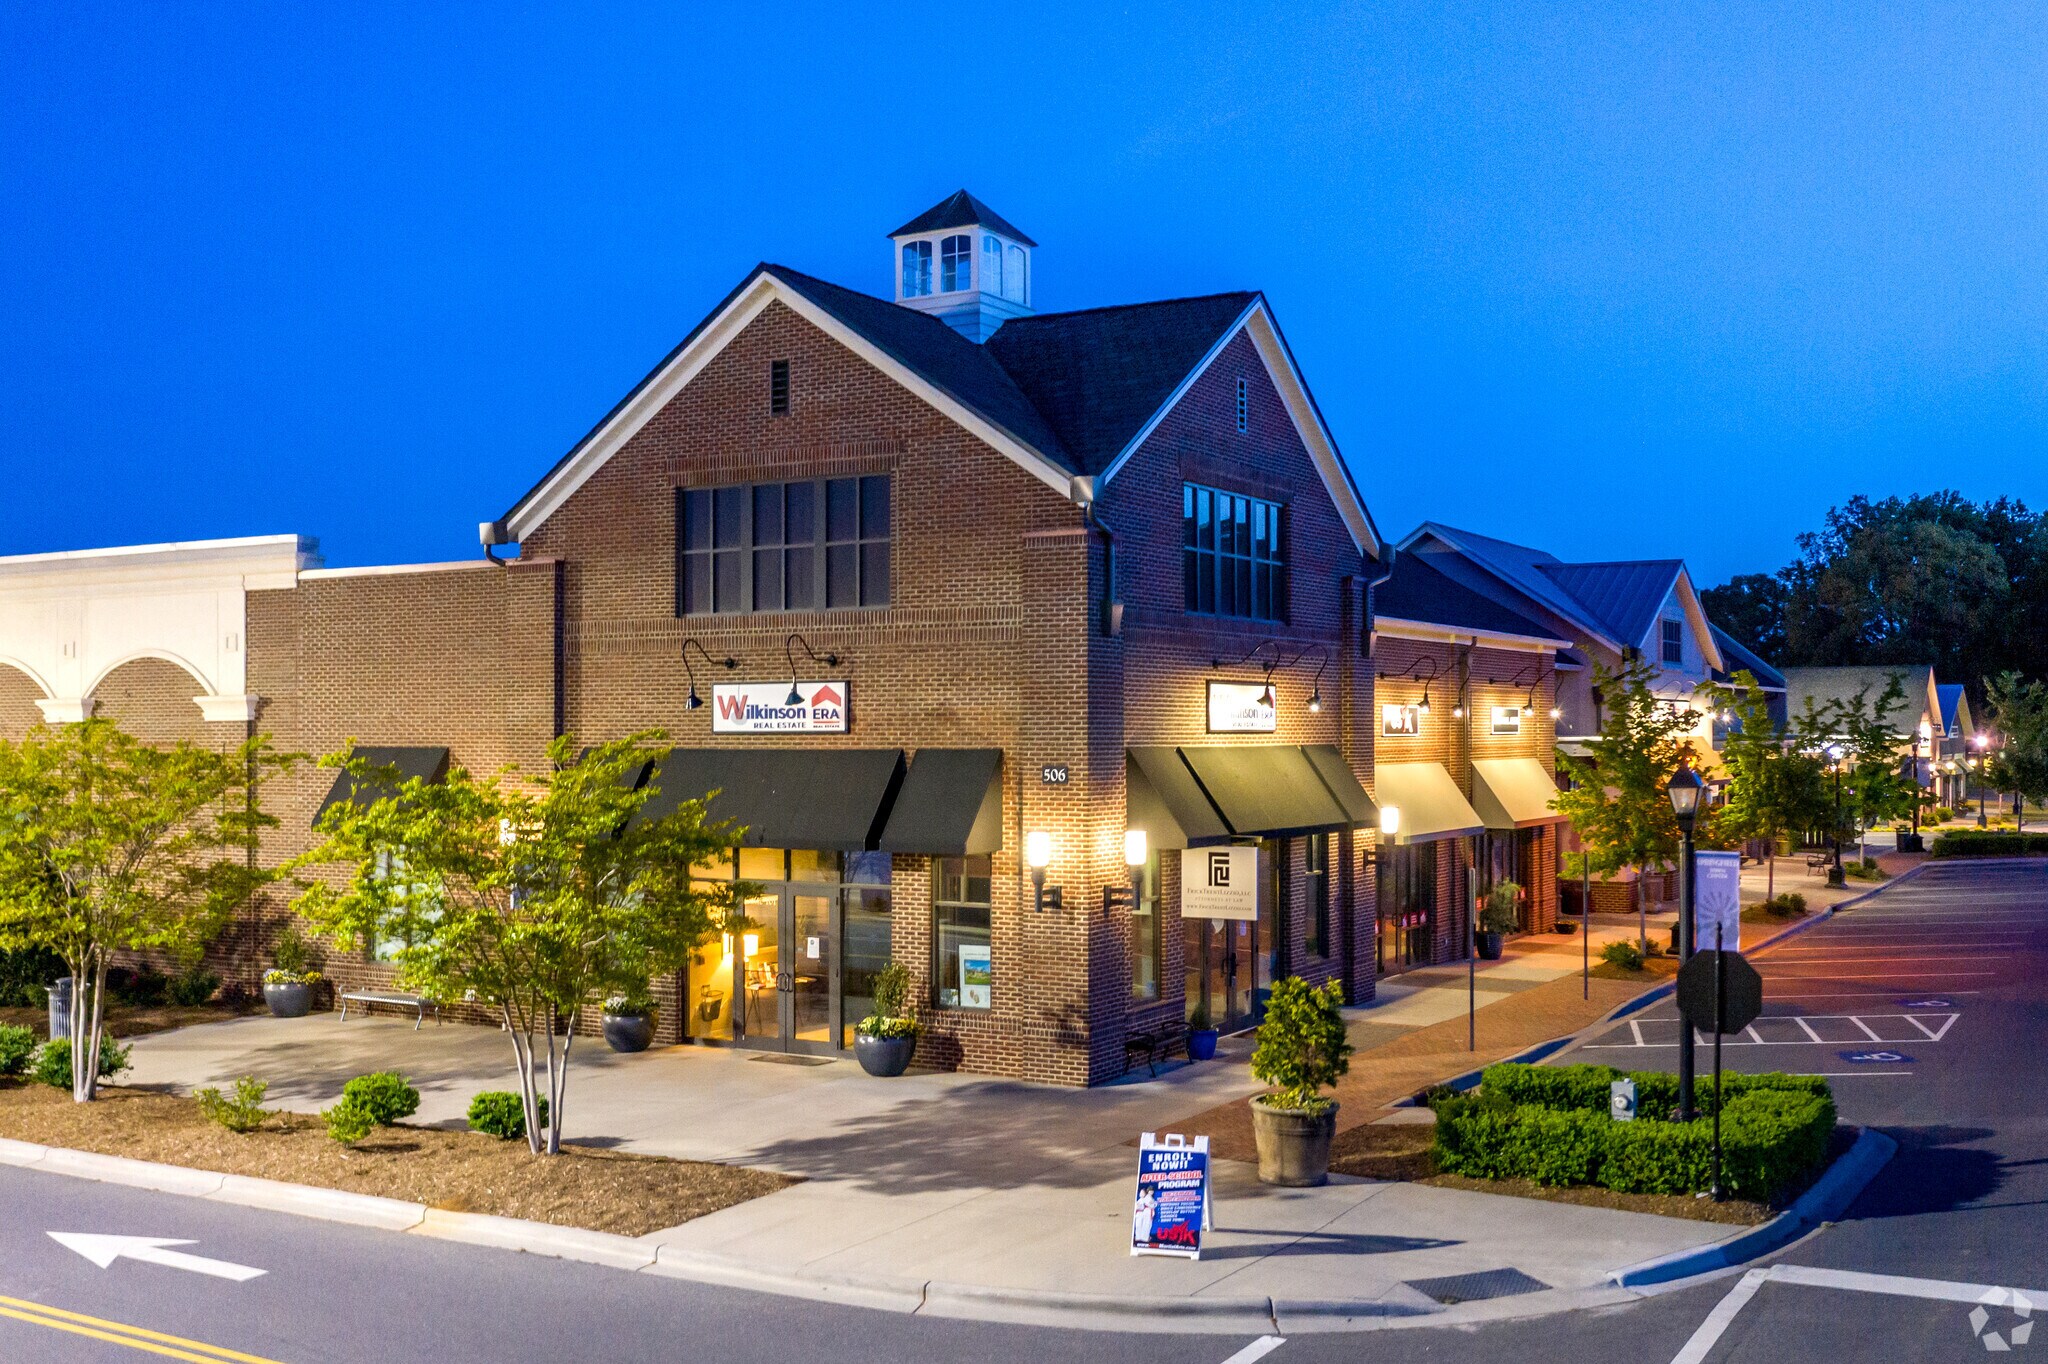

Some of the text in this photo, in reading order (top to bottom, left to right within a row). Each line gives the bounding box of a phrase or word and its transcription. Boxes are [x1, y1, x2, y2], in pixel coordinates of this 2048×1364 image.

[717, 695, 806, 720] Wilkinson
[813, 708, 840, 719] ERA
[777, 721, 806, 729] ESTATE
[1043, 768, 1066, 782] 506
[1148, 1152, 1193, 1163] ENROLL
[1152, 1160, 1188, 1171] NOW!!
[1158, 1179, 1200, 1189] PROGRAM
